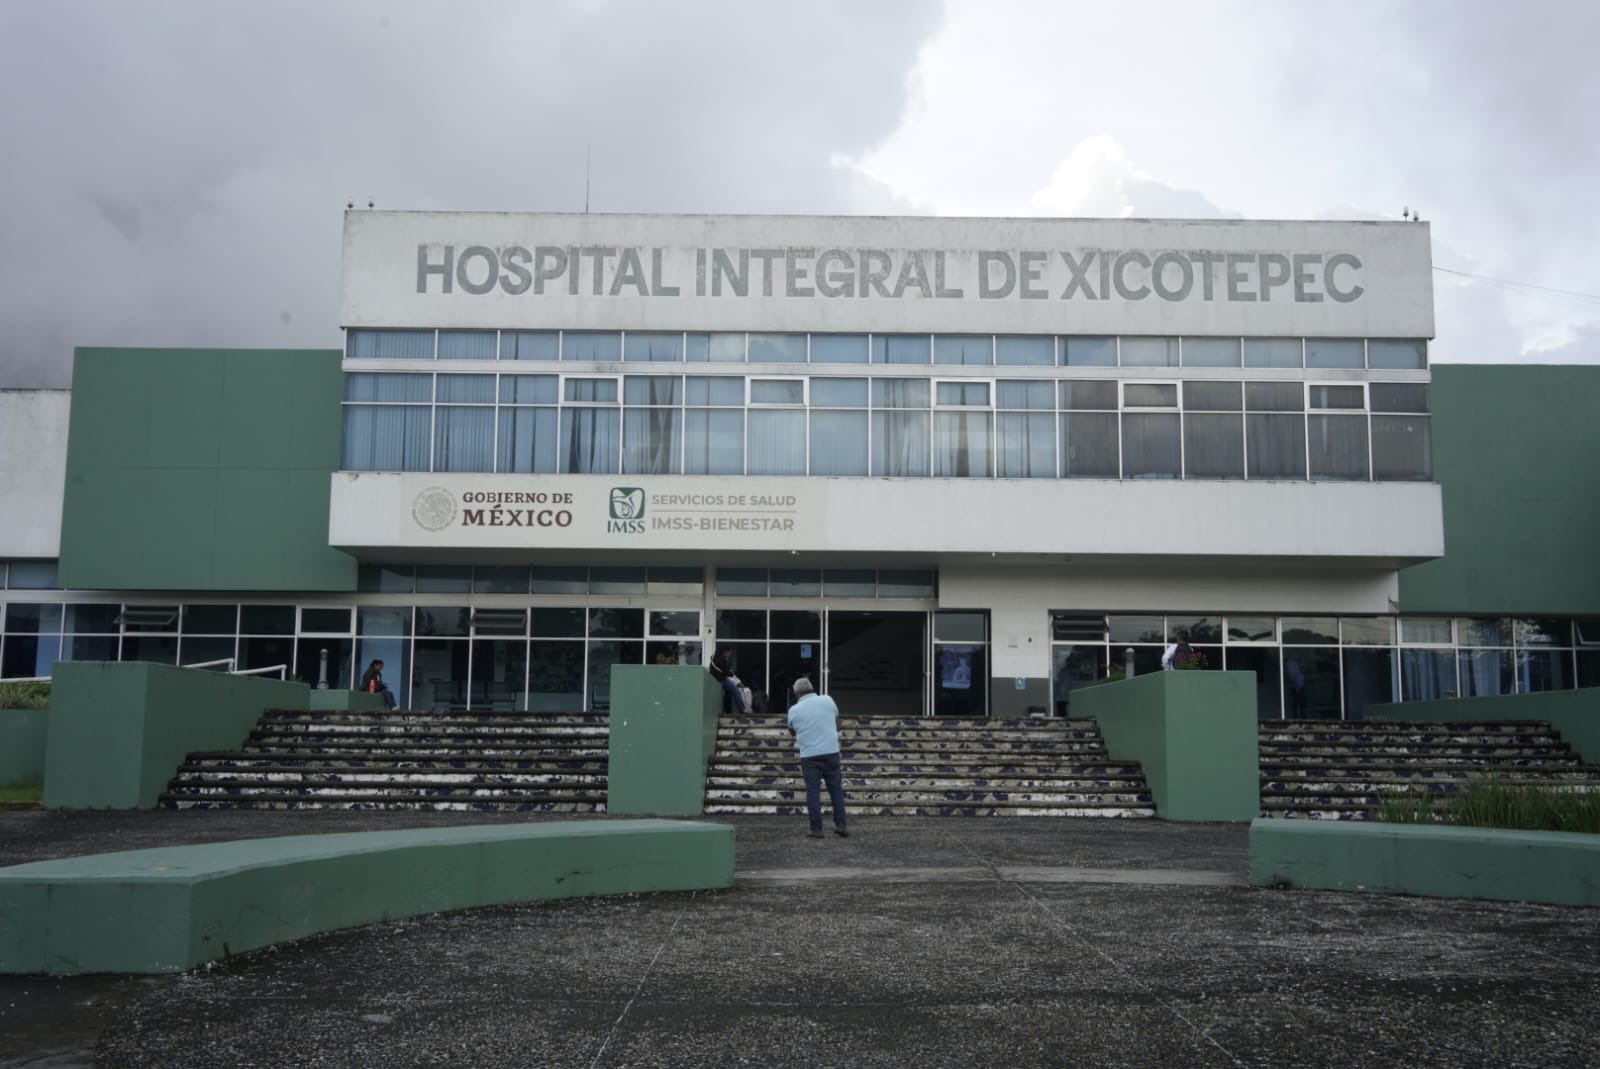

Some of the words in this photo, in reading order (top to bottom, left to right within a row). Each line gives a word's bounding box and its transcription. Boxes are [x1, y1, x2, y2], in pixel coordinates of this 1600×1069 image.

[416, 244, 680, 297] HOSPITAL
[696, 247, 963, 299] INTEGRAL
[978, 250, 1048, 300] DE
[1060, 251, 1364, 303] XICOTEPEC
[462, 492, 548, 504] GOBIERNO
[551, 493, 573, 504] DE
[652, 494, 724, 506] SERVICIOS
[727, 495, 747, 506] DE
[750, 495, 796, 506] SALUD
[461, 504, 573, 527] MÉXICO
[607, 520, 646, 534] IMSS
[652, 517, 794, 531] IMSS-BIENESTAR
